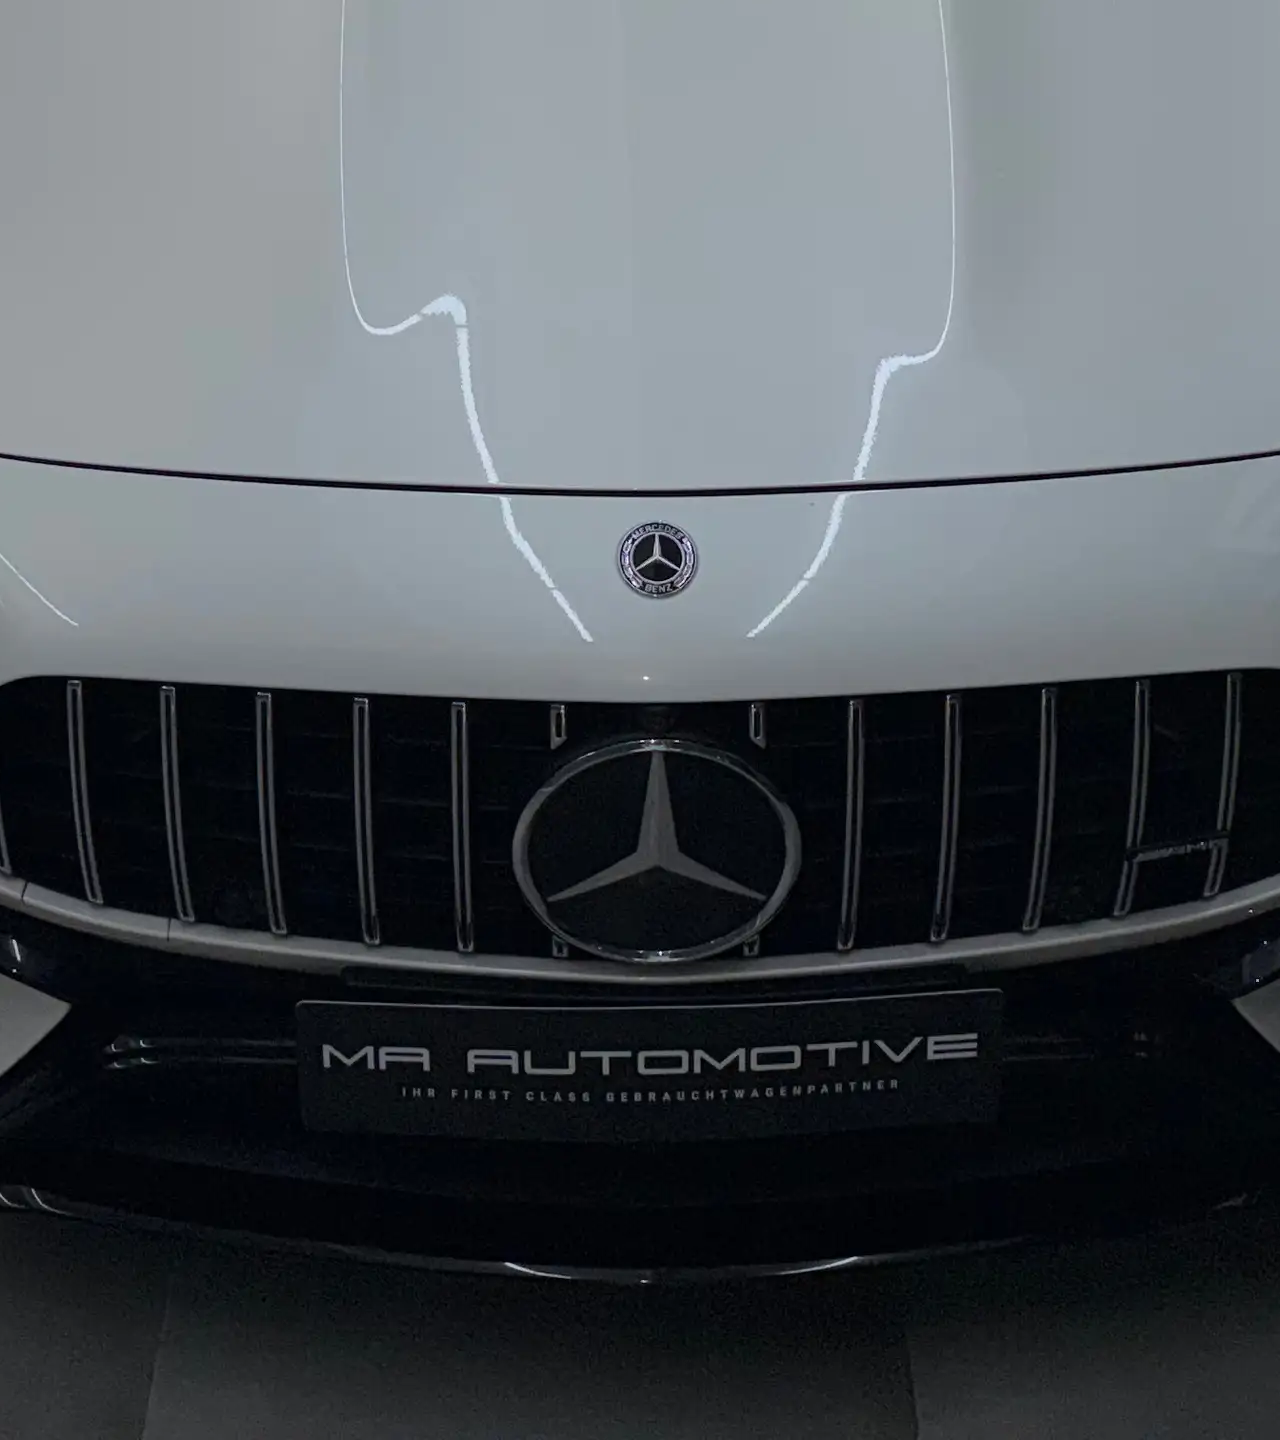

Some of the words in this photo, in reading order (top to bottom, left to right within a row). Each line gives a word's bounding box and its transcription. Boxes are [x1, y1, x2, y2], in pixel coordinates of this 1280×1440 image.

[631, 523, 684, 540] MERCEDES
[644, 583, 673, 593] BENZ
[322, 1043, 431, 1072] MA
[466, 1033, 979, 1076] AUTOMOTIVE
[401, 1087, 436, 1098] IHR
[451, 1089, 511, 1101] FIRST
[525, 1090, 591, 1103] CLASS
[605, 1078, 900, 1103] GEBRAUCHTWAGENPARTNER
